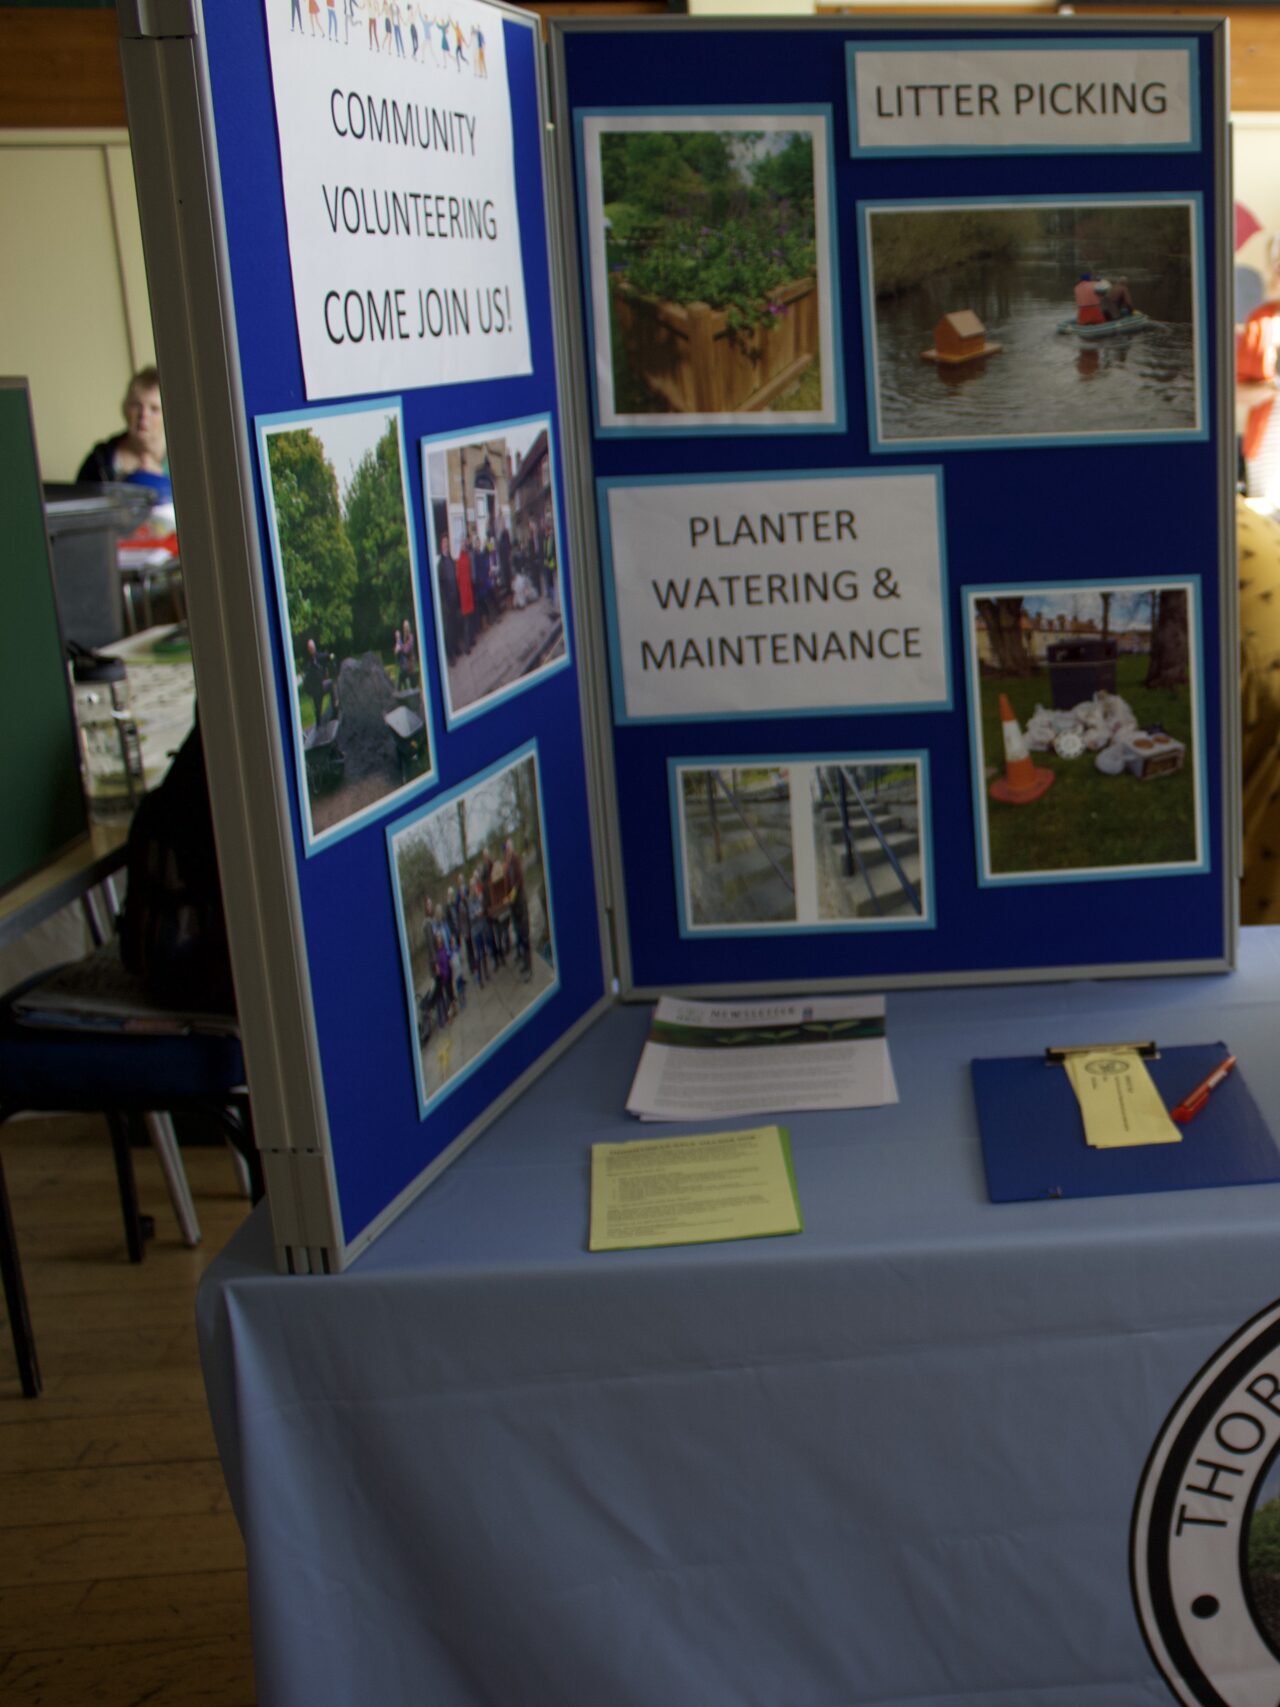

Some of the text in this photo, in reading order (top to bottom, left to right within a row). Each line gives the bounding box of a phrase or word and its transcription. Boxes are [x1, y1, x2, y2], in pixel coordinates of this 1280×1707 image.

[330, 87, 478, 156] COMMUNITY
[876, 81, 1167, 118] LITTER PICKING
[322, 184, 498, 241] VOLUNTEERING
[323, 284, 514, 345] COME JOIN US!
[689, 509, 858, 549] PLANTER
[651, 567, 901, 611] WATERING &
[640, 627, 922, 672] MAINTENANCE
